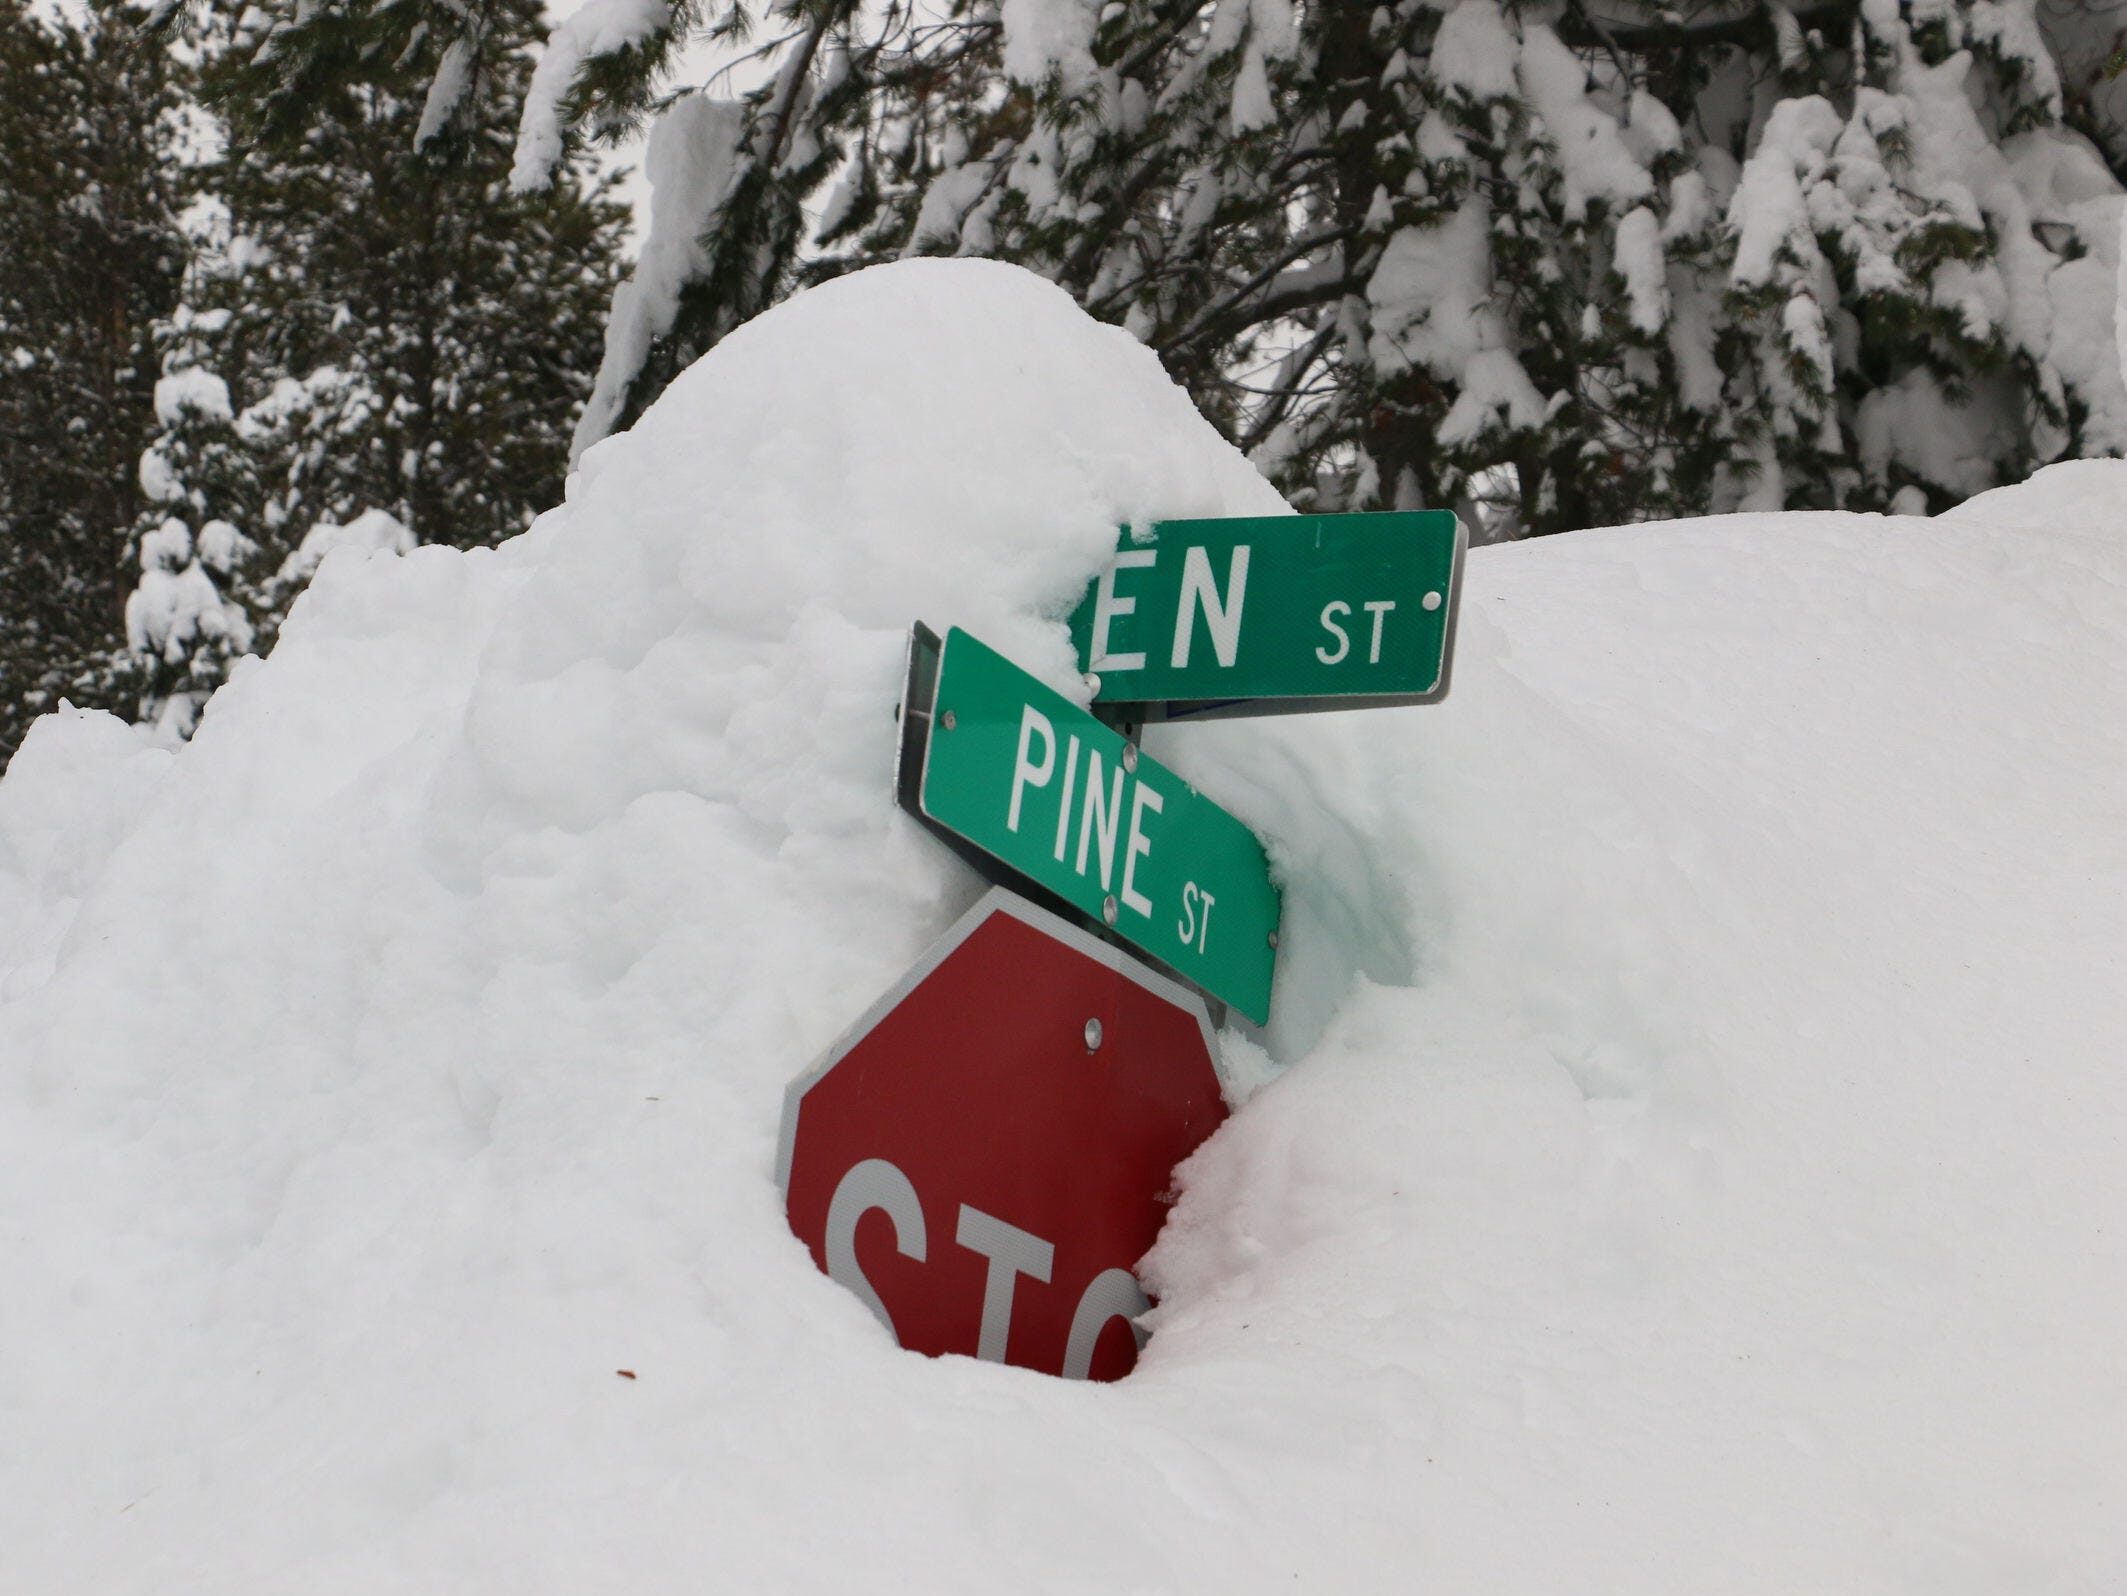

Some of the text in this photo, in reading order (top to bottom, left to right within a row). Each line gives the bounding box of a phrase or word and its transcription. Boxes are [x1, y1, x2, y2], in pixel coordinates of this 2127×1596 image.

[1089, 545, 1396, 672] EN ST
[1007, 703, 1215, 954] PINE ST
